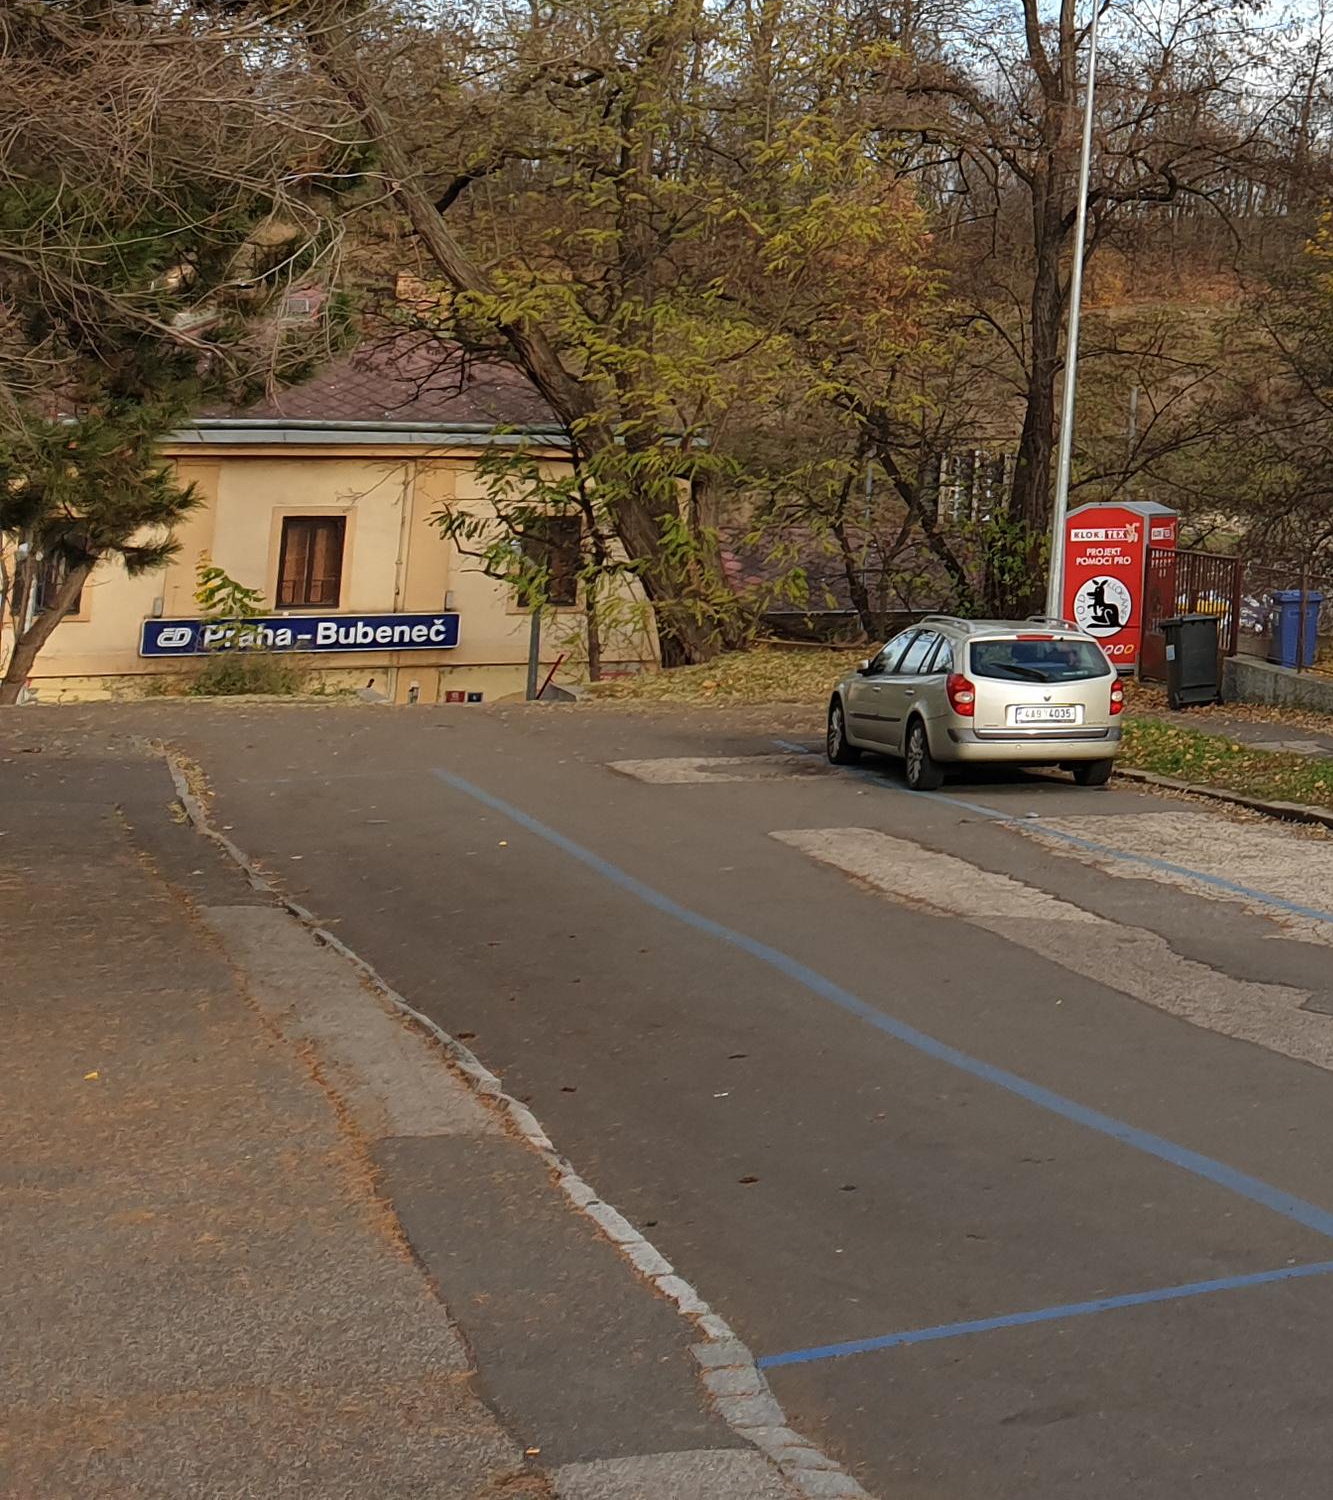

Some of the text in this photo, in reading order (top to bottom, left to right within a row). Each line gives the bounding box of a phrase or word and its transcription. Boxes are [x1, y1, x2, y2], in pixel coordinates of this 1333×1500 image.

[1086, 547, 1122, 557] PROJEKT
[1076, 556, 1132, 566] POMOCI PRO
[316, 619, 447, 645] Bubeneč
[1048, 708, 1071, 719] 4035
